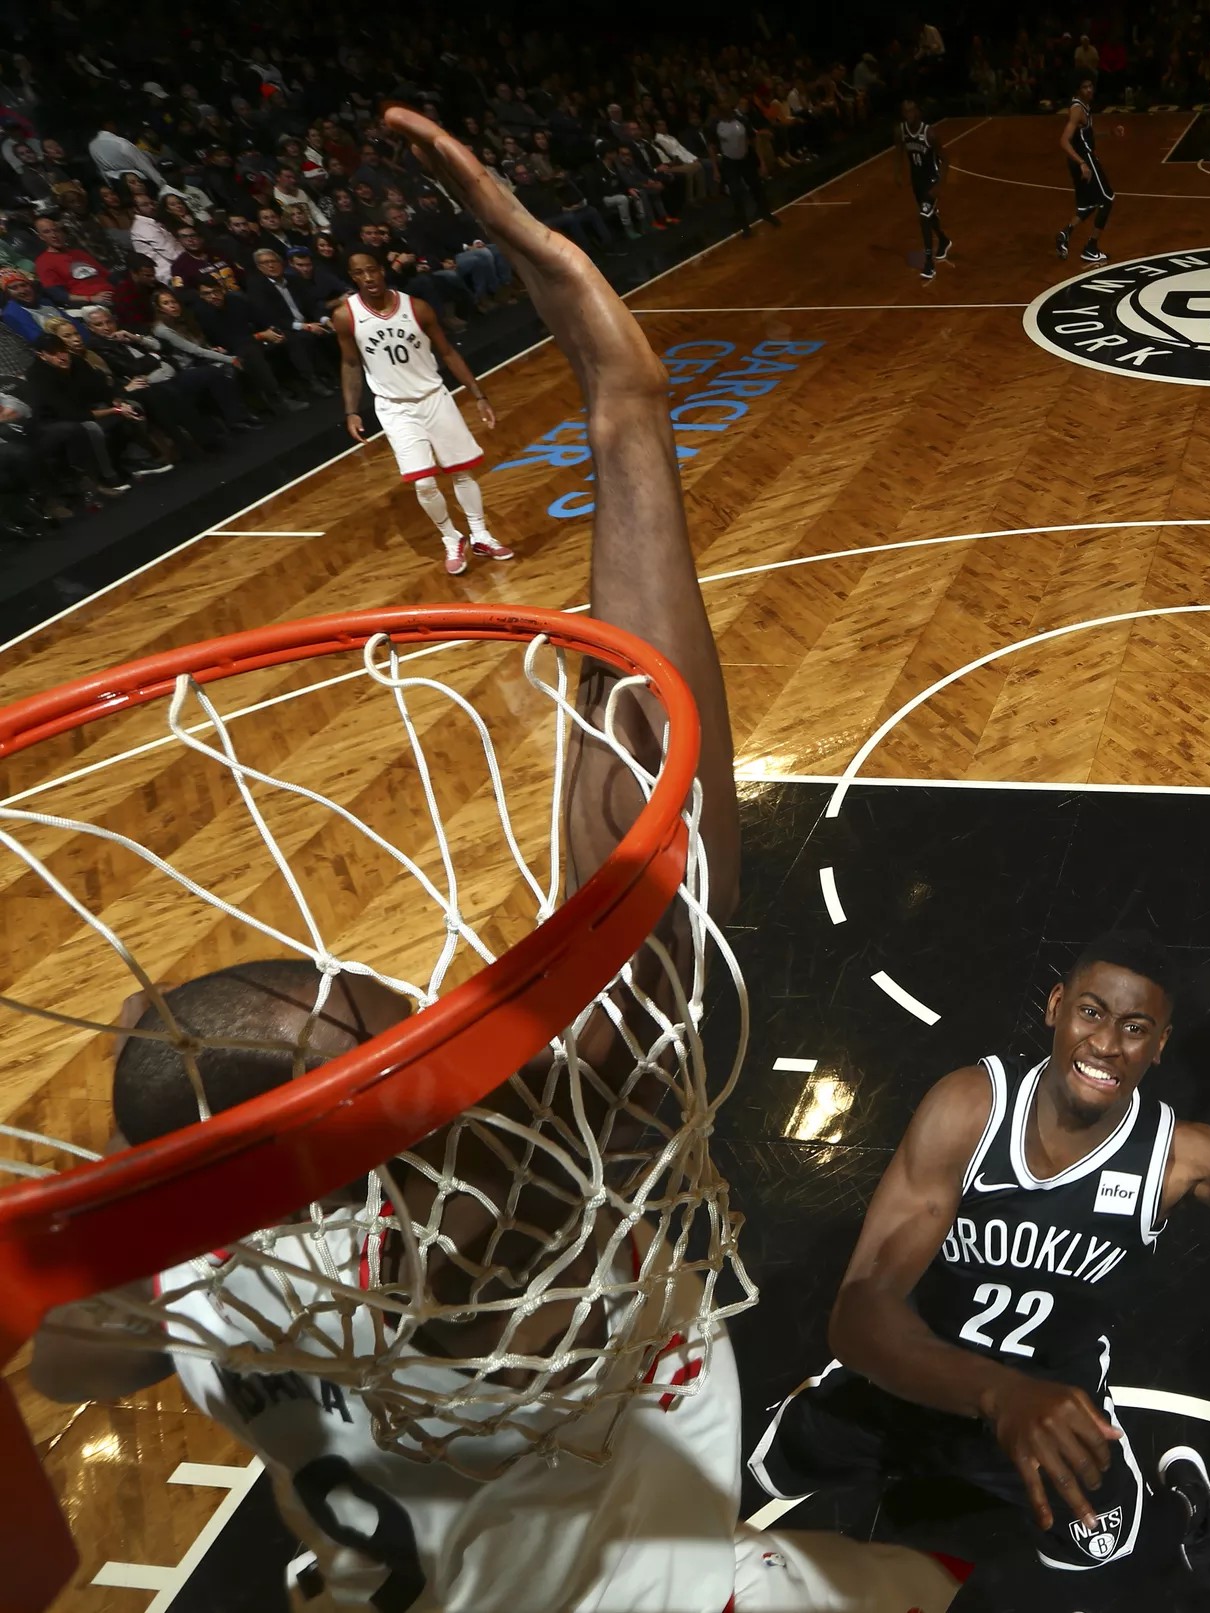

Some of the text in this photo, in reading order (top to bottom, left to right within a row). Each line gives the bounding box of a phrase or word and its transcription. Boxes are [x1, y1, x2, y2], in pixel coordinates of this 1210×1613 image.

[1081, 254, 1210, 294] NEW
[365, 327, 422, 355] RAPTORS
[383, 344, 409, 365] 10
[1052, 306, 1173, 368] YORK
[1099, 1183, 1136, 1200] infor
[941, 1217, 1128, 1285] BROOKLYN
[958, 1282, 1055, 1358] 22
